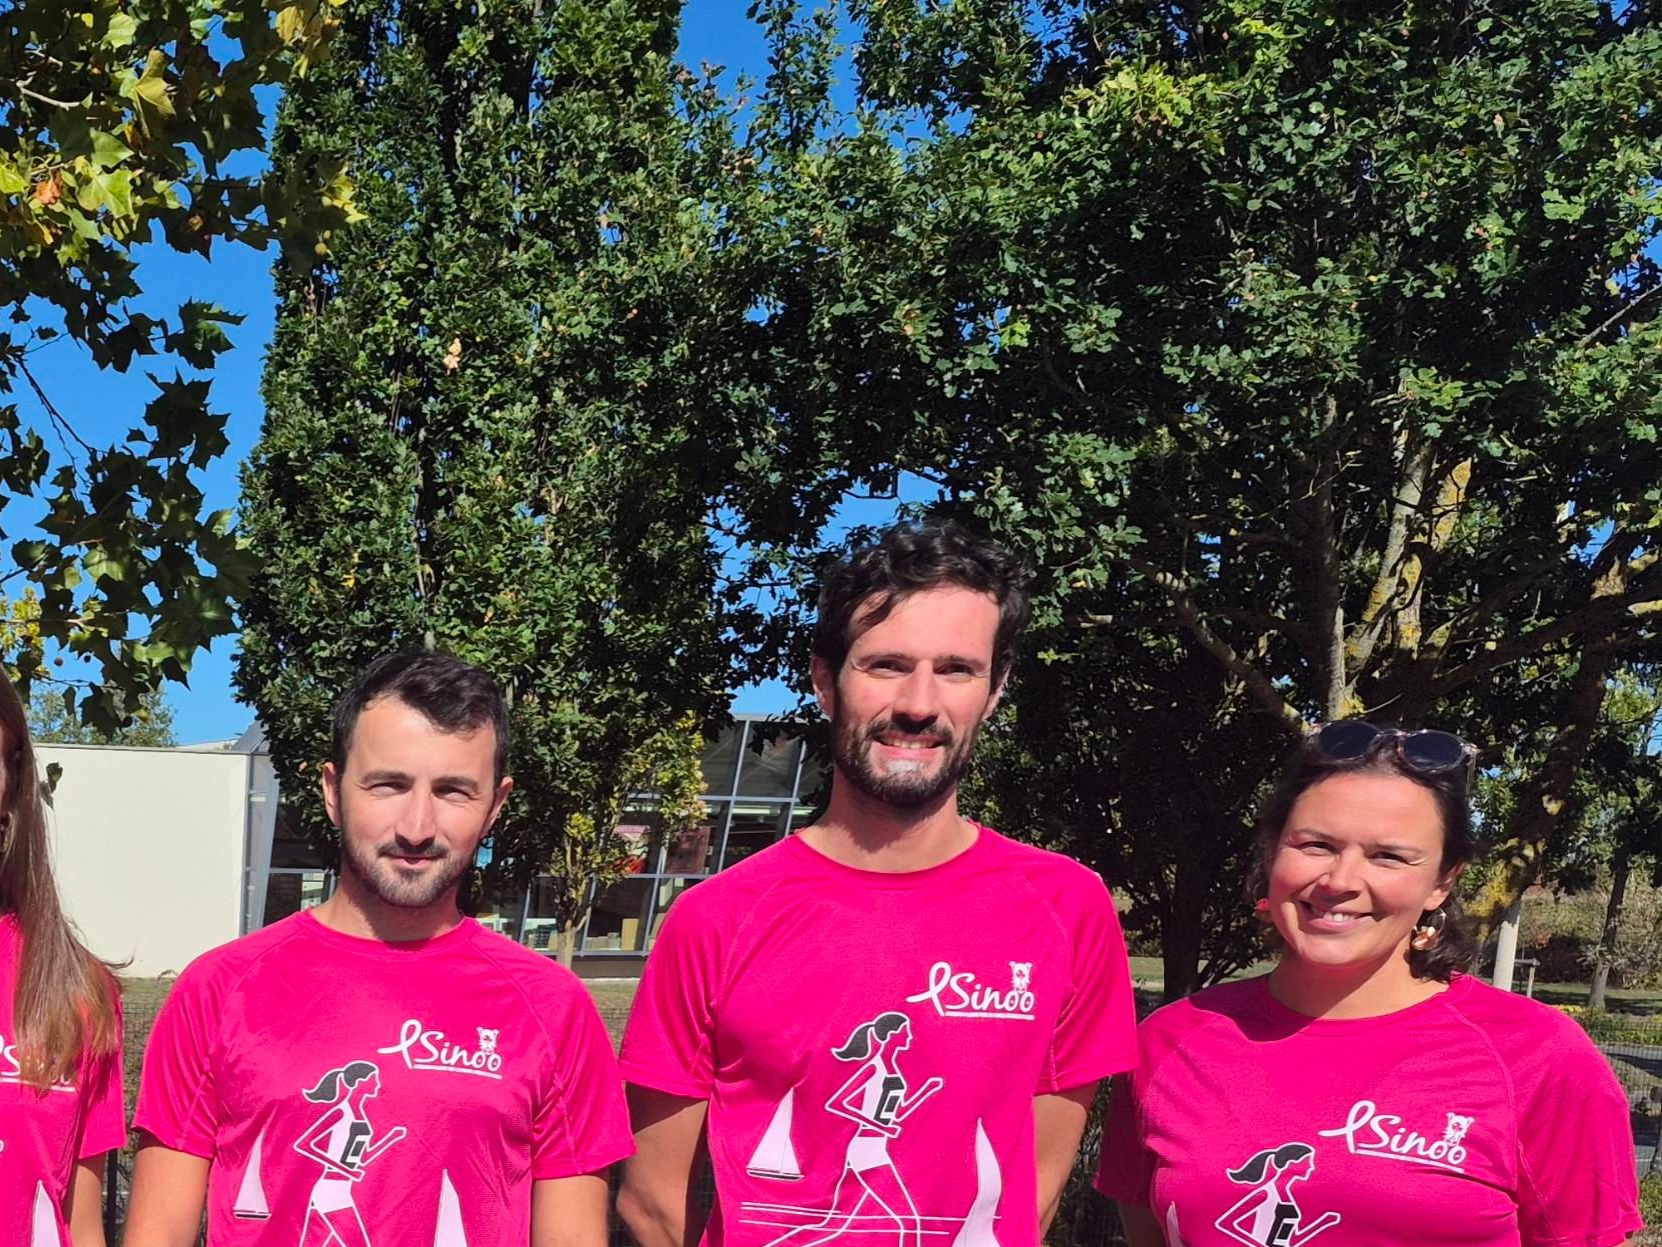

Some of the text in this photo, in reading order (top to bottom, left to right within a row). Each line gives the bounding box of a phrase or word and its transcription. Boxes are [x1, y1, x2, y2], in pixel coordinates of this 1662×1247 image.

[945, 972, 1035, 1013] Sinoo
[413, 1030, 502, 1072] Sinoo
[1358, 1114, 1467, 1165] Sinoo
